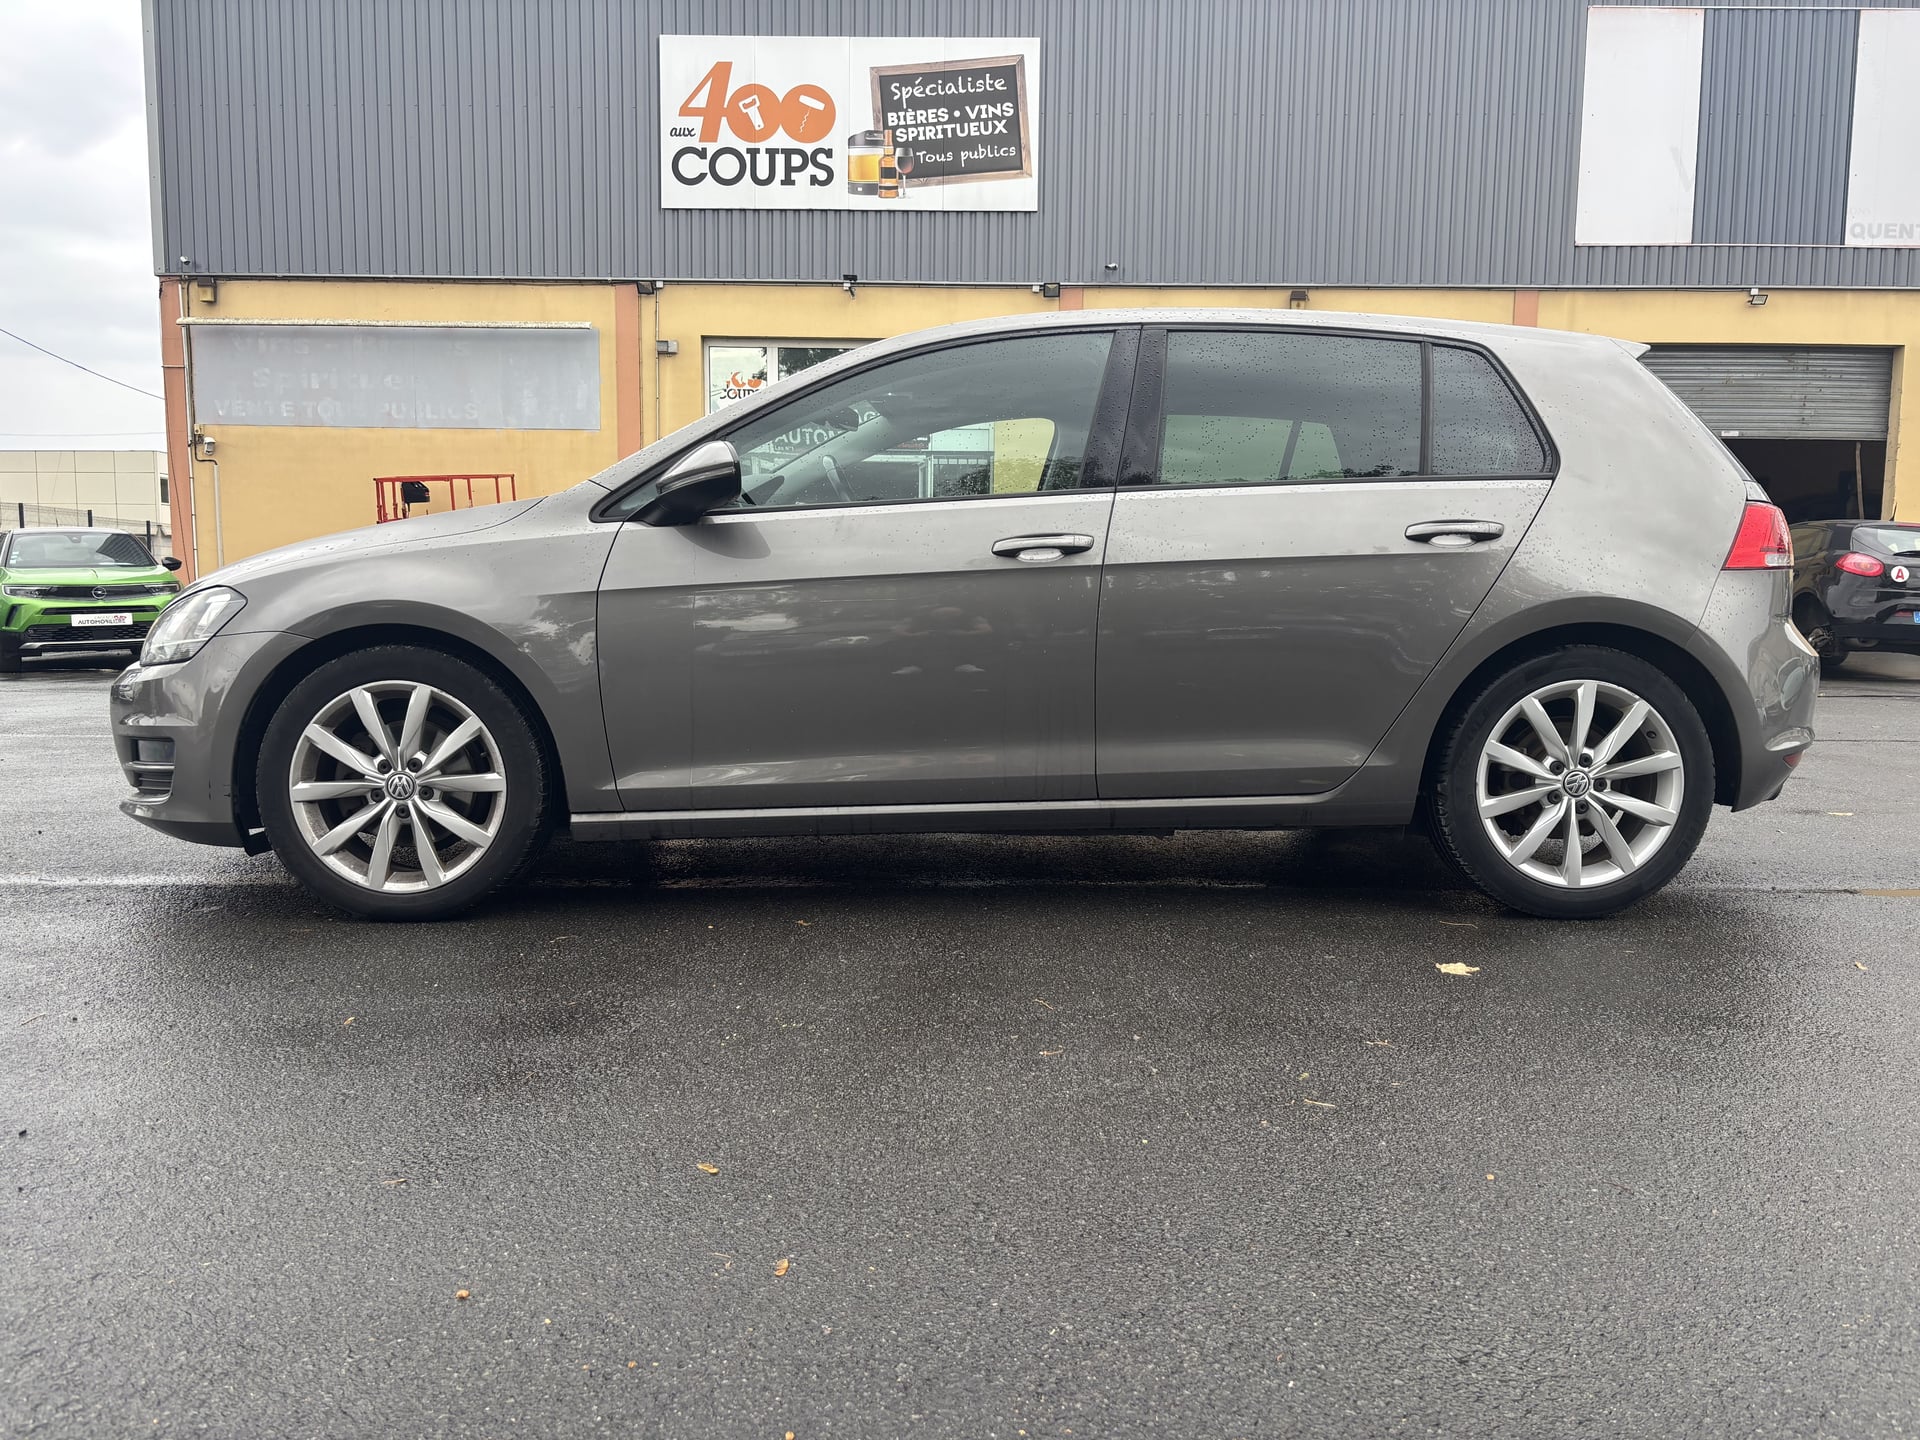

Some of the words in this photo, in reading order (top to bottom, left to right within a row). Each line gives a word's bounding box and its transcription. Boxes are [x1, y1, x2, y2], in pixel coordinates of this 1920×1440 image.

[678, 61, 836, 143] 400
[890, 73, 1007, 109] Spécialiste
[887, 108, 949, 127] BIÈRES
[965, 102, 1014, 119] VINS
[670, 126, 696, 137] aux
[895, 120, 1008, 142] SPIRITUEUX
[671, 146, 834, 187] COUPS
[916, 151, 954, 164] Tous
[961, 144, 1016, 168] publics
[1895, 568, 1905, 579] A
